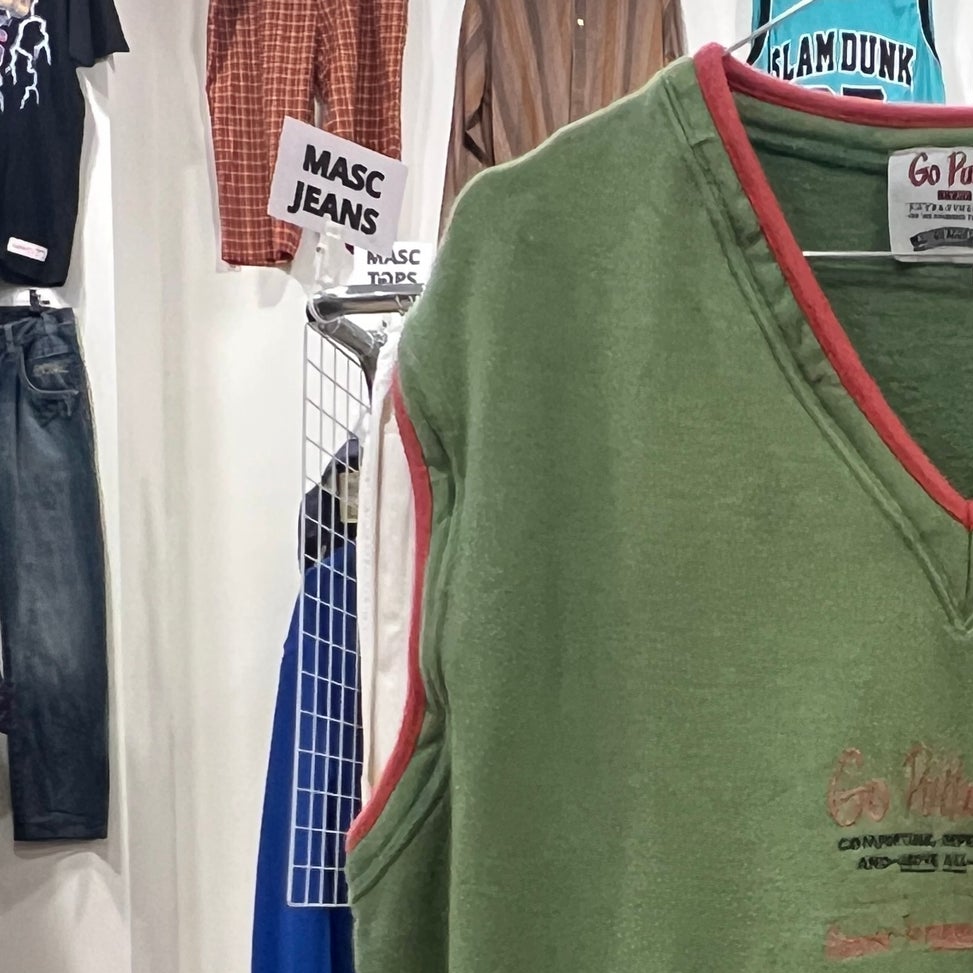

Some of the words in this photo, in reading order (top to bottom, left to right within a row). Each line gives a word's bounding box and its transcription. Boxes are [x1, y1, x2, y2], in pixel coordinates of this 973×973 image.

[770, 29, 837, 81] SLAM
[838, 29, 917, 88] DUNK
[302, 144, 385, 199] MASC
[908, 152, 941, 187] Go
[287, 180, 380, 235] JEANS
[366, 249, 421, 265] MASC
[367, 271, 418, 285] TOPS
